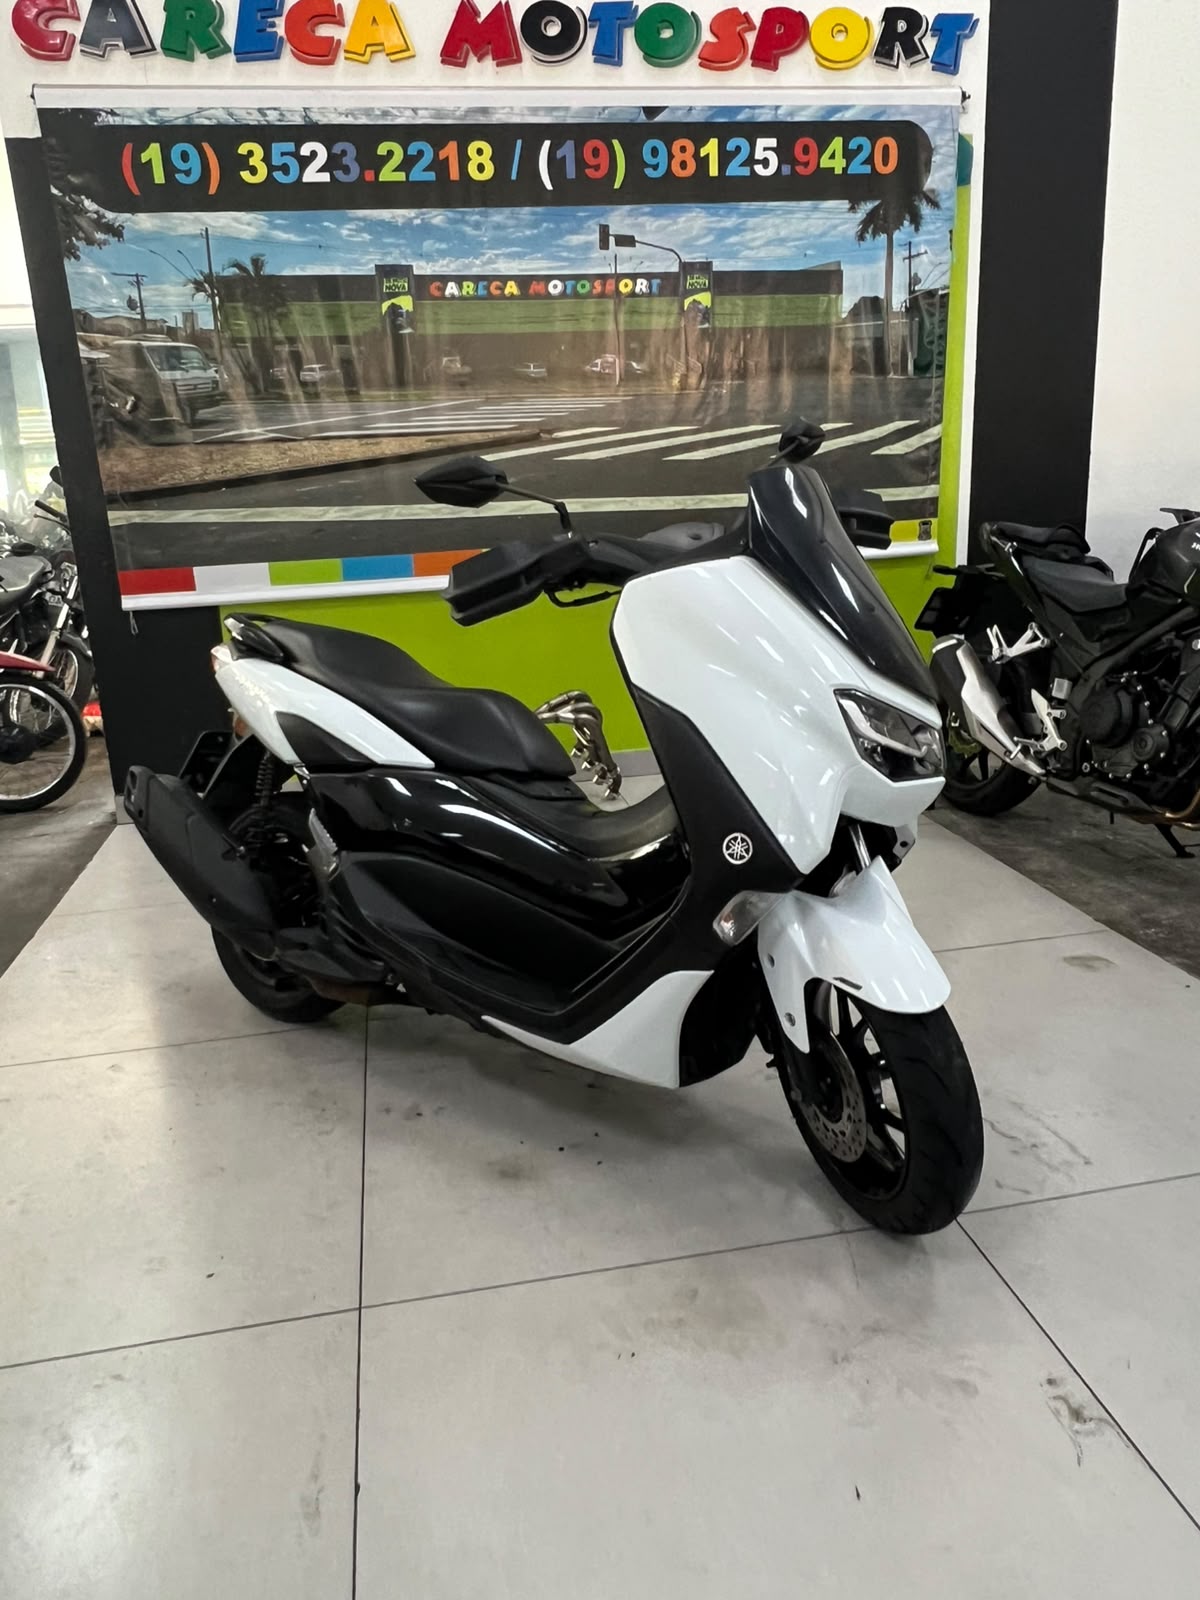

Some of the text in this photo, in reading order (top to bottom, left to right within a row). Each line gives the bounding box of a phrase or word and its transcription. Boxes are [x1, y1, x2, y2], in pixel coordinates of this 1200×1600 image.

[11, 0, 979, 75] CARECA MOTOSPORT
[121, 142, 220, 196] (19)
[237, 140, 495, 184] 3523.2218
[538, 139, 626, 190] (19)
[642, 136, 899, 178] 98125.9420
[429, 280, 521, 297] CARECA
